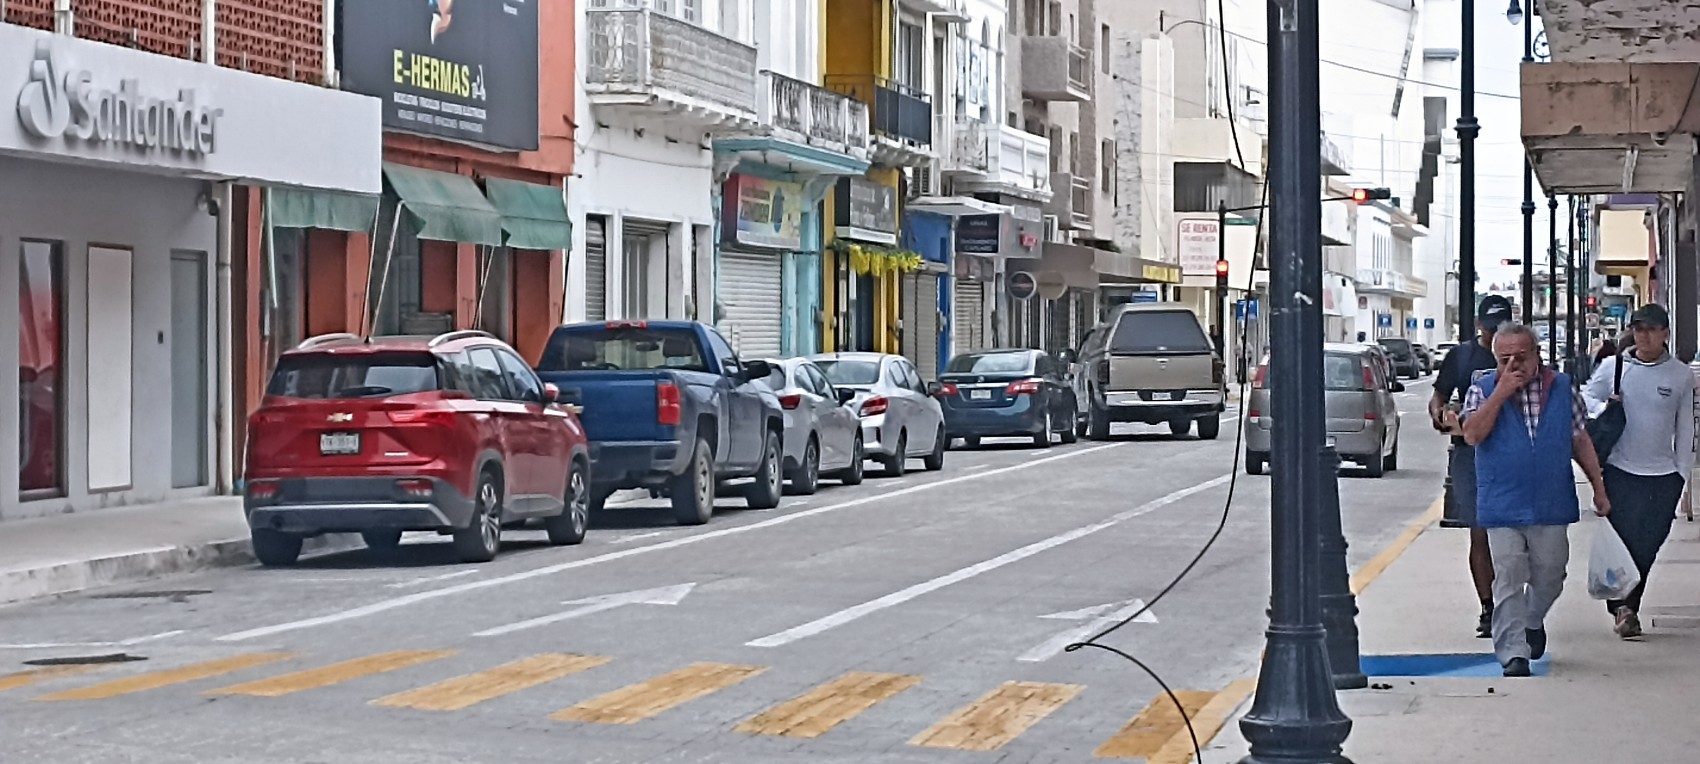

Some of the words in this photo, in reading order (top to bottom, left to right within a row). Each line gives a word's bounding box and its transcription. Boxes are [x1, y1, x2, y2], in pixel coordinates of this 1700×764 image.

[393, 48, 470, 98] E-HERMAS
[64, 70, 224, 154] Santander
[1181, 223, 1191, 233] SE
[1193, 223, 1218, 233] RENTA
